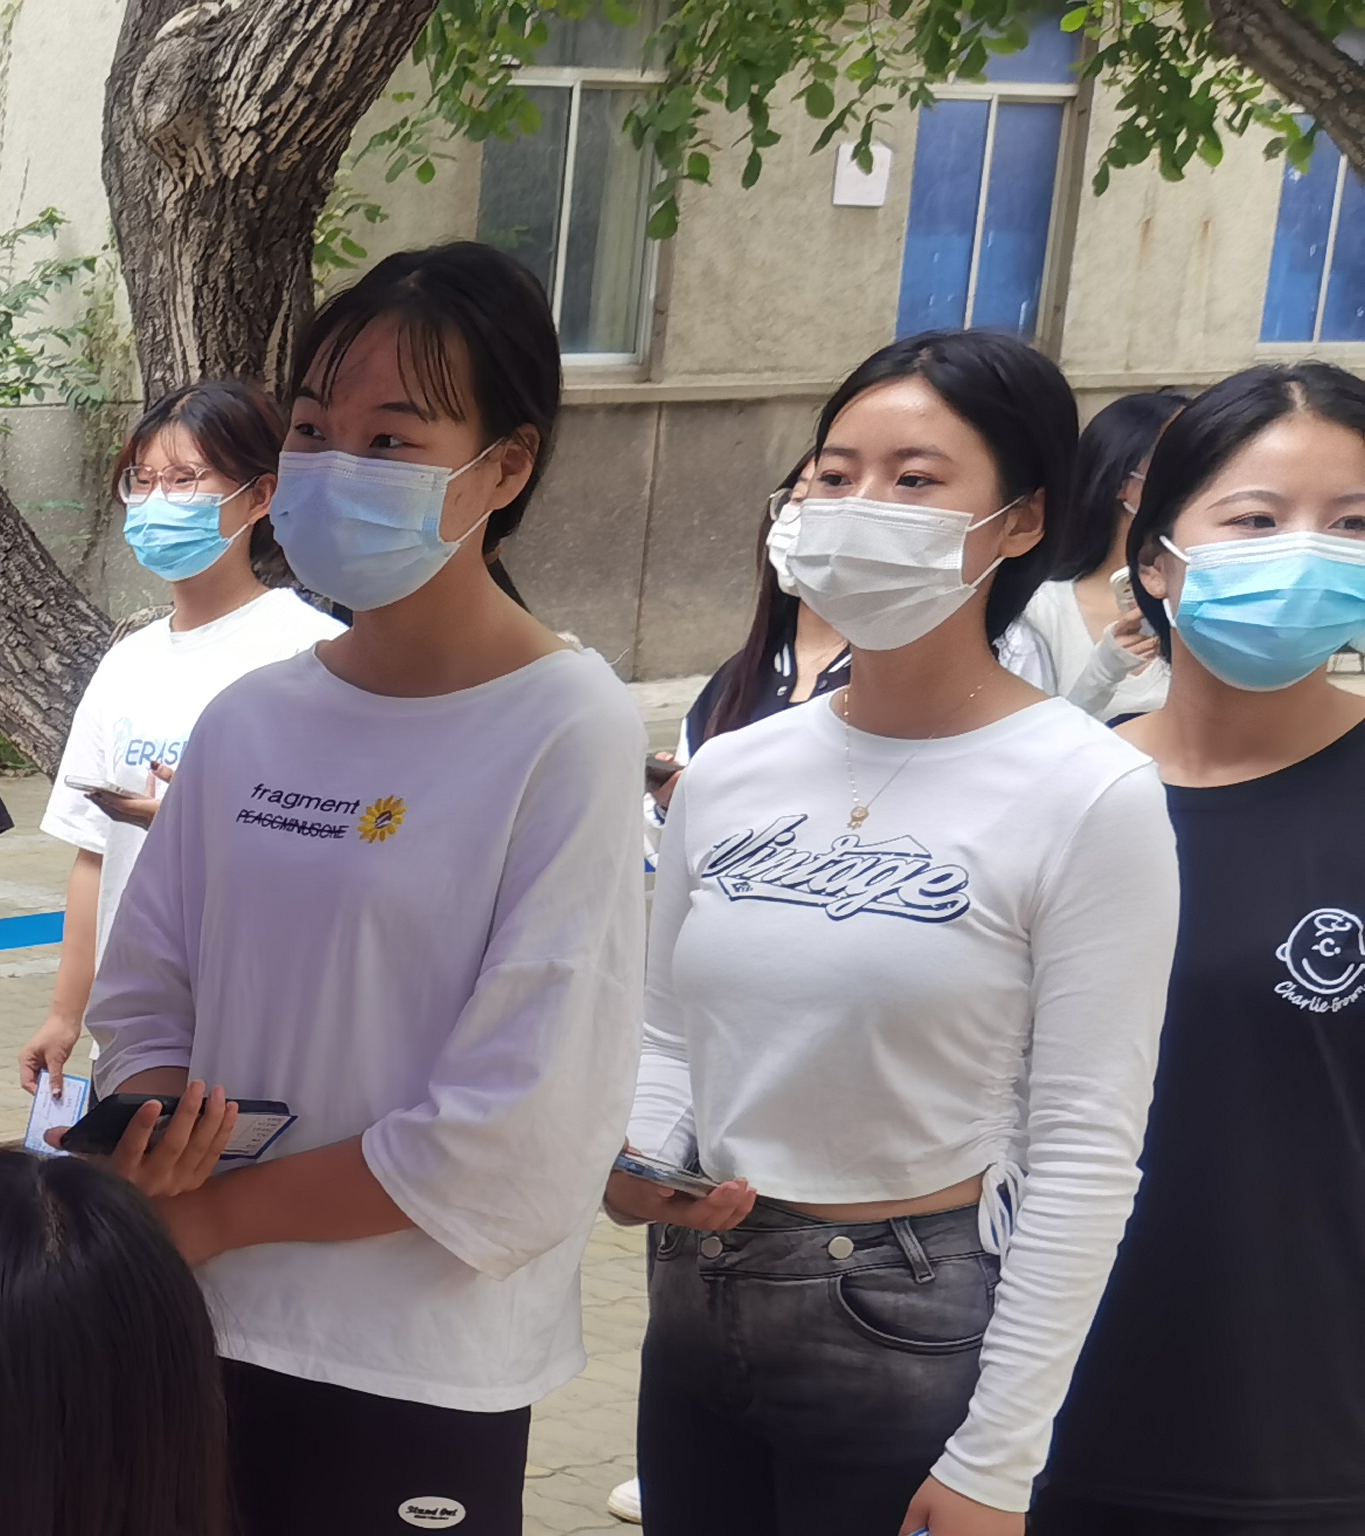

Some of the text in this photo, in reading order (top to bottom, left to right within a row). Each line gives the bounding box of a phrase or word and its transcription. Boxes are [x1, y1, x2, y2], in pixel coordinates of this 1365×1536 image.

[251, 783, 361, 815] fragment
[701, 814, 970, 923] Vintage
[1274, 980, 1330, 1013] Charlie
